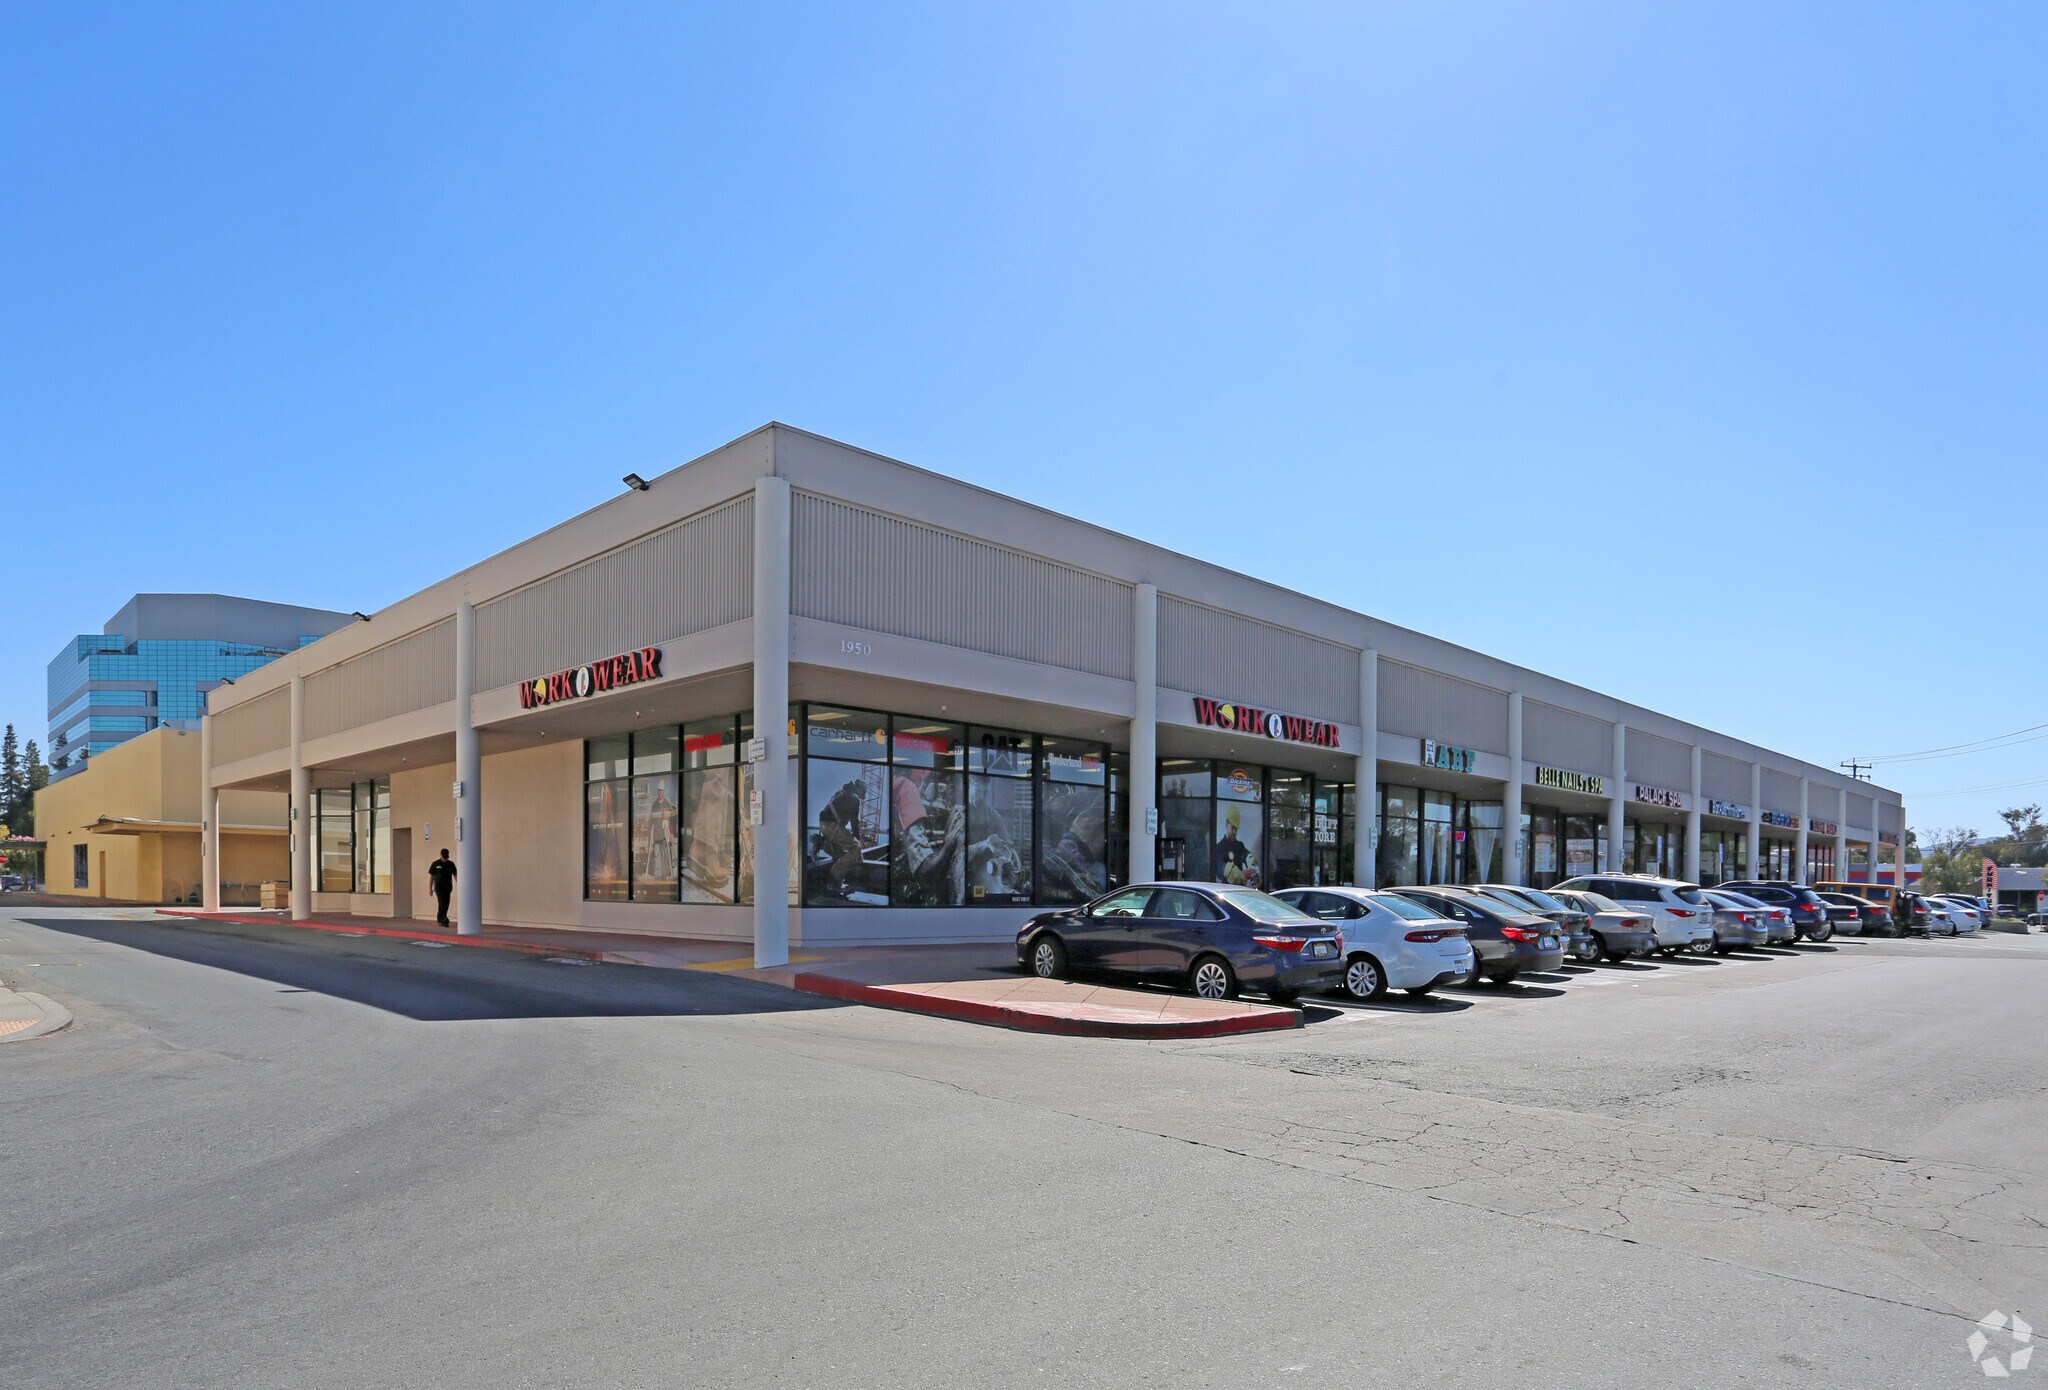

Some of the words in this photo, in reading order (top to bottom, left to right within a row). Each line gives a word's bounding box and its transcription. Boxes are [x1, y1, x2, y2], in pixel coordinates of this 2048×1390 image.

[840, 640, 872, 656] 1950
[518, 669, 575, 709] WORK
[592, 647, 661, 692] WEAR
[1194, 697, 1266, 734] WORK
[1283, 715, 1340, 748] WEAR
[982, 733, 1021, 771] CAT
[1048, 752, 1082, 767] Timberland
[1538, 766, 1560, 786] BELLE
[1562, 770, 1584, 791] NAILS
[1590, 776, 1603, 794] SPA
[1639, 785, 1667, 804] PALACE
[1668, 790, 1683, 807] SPA
